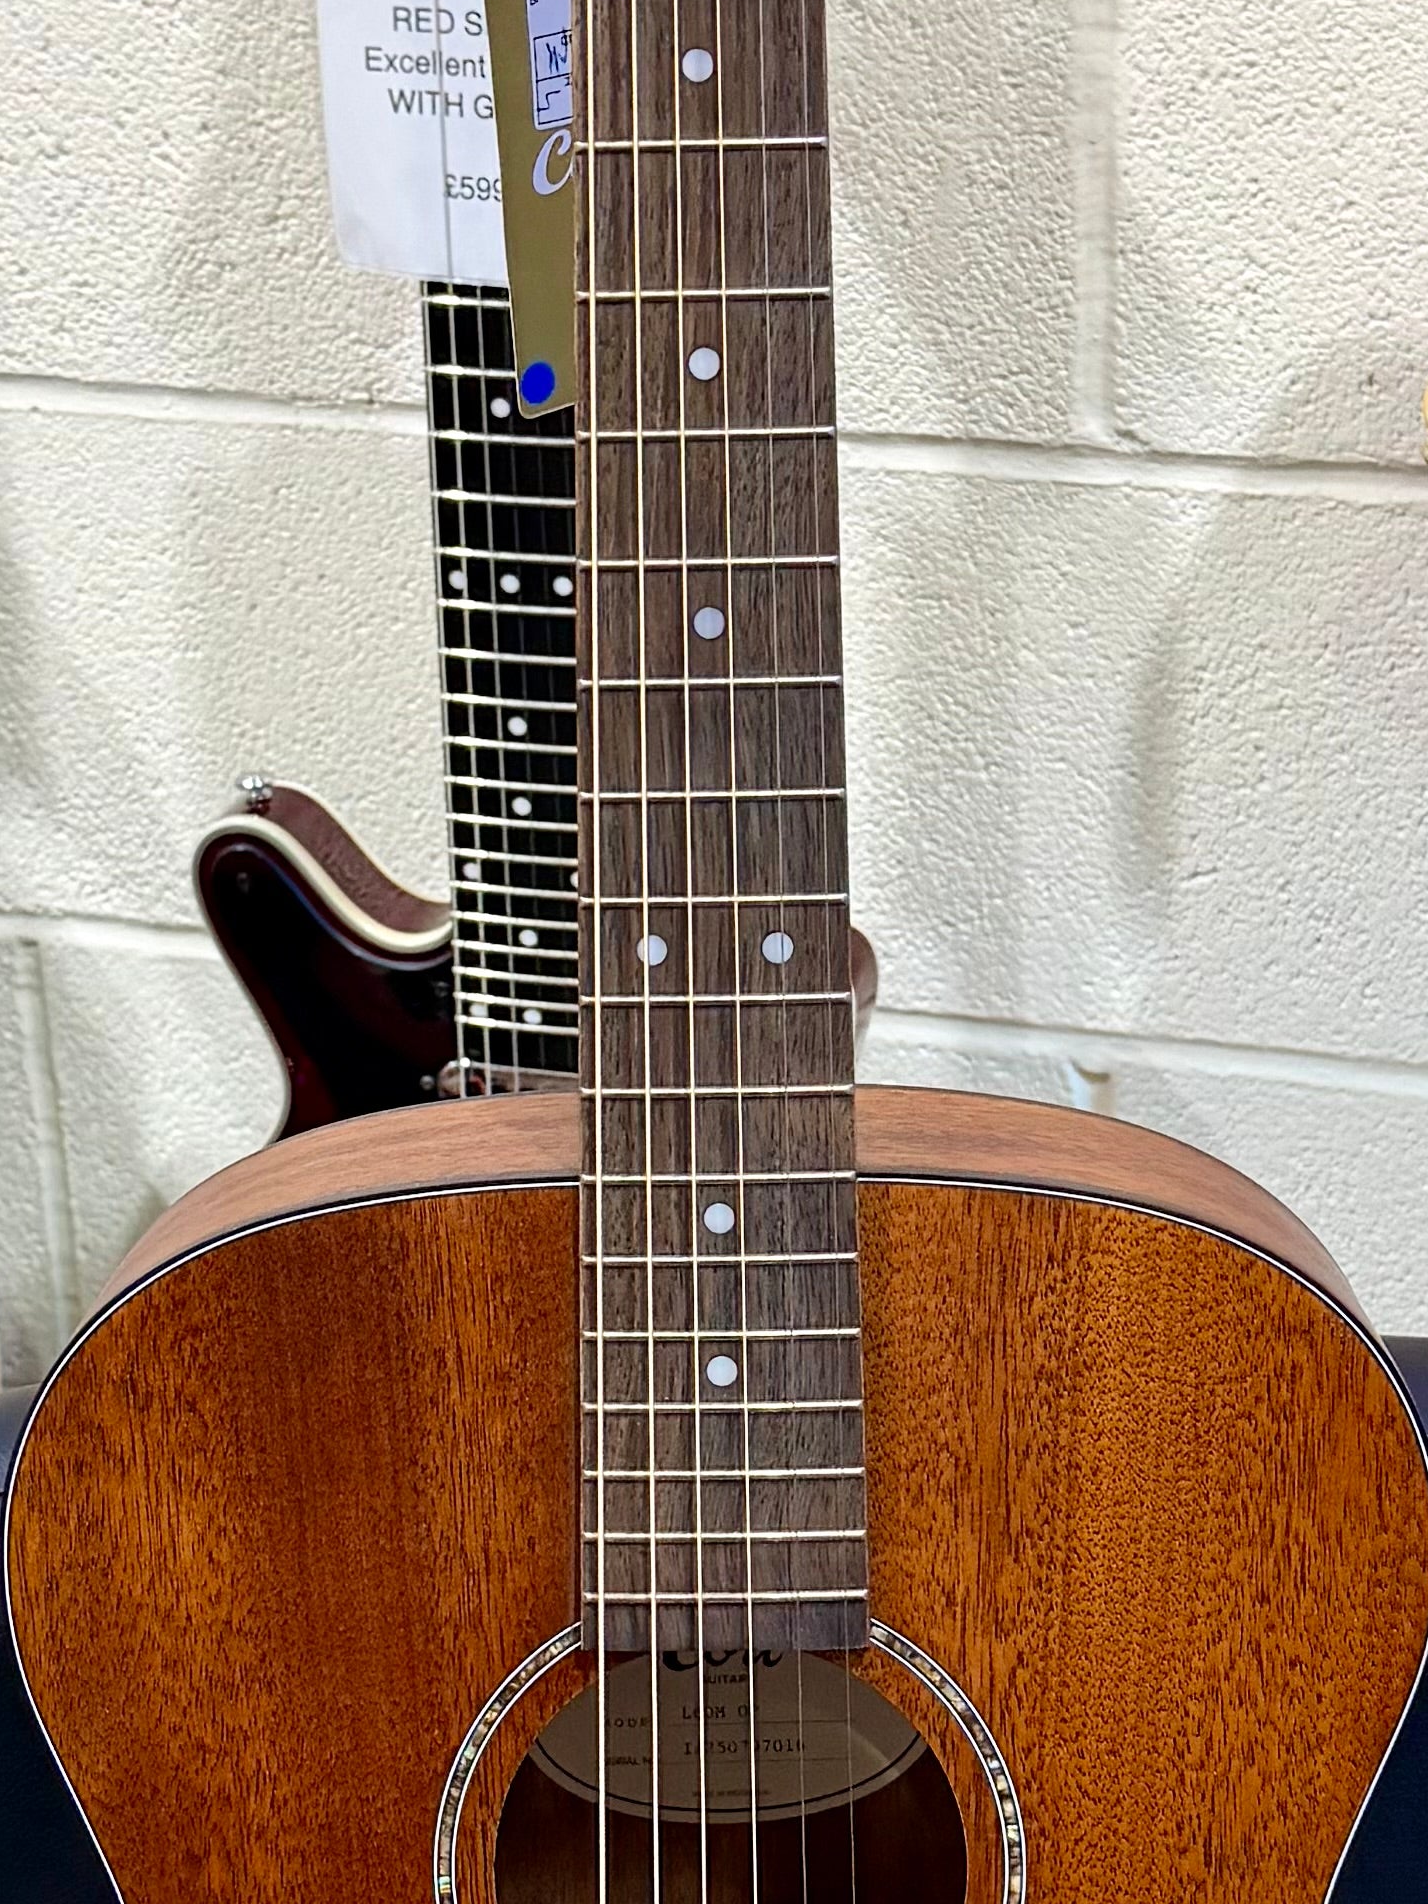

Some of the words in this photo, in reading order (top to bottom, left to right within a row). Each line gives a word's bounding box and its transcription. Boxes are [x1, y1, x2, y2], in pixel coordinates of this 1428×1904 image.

[392, 6, 455, 35] RED
[365, 46, 487, 78] Excellent
[387, 87, 464, 118] WITH
